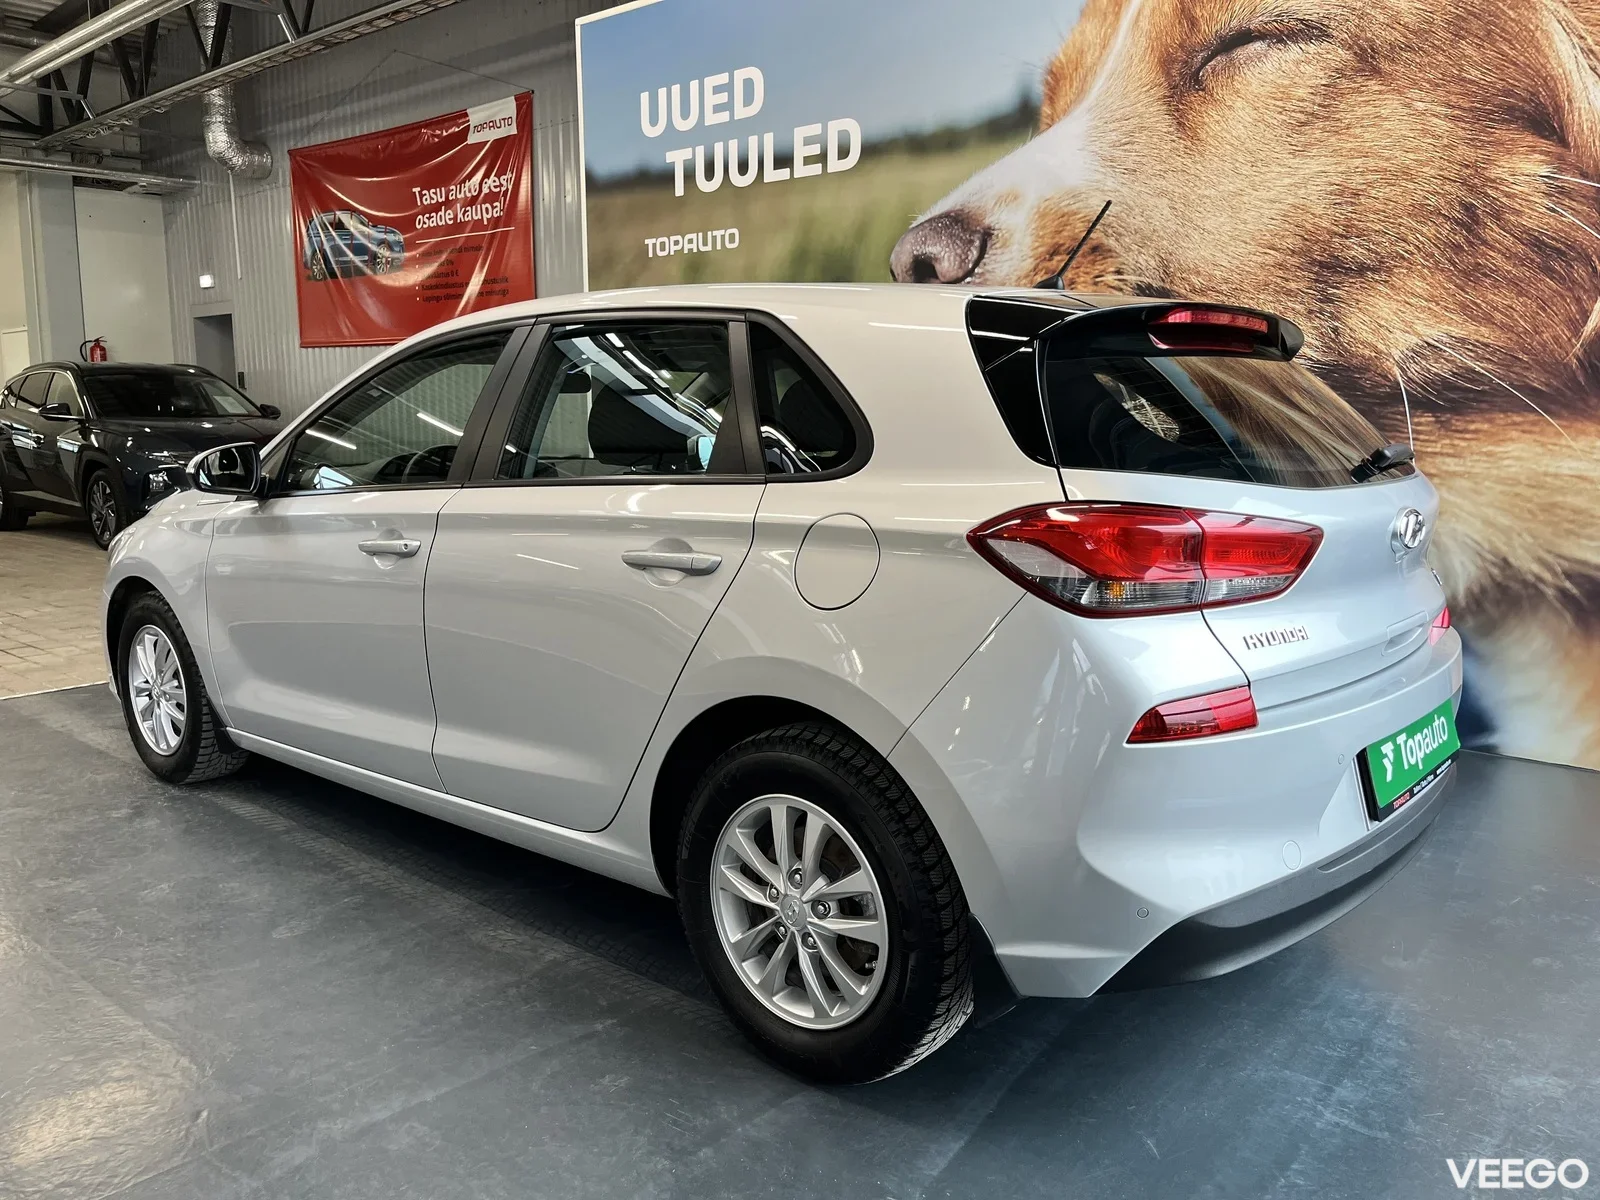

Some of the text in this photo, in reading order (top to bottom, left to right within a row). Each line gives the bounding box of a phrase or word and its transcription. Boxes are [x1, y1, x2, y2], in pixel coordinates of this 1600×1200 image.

[640, 66, 764, 137] UUED
[472, 116, 513, 134] TOPAUTO
[665, 118, 862, 197] TUULED
[412, 171, 513, 207] Tasu auto eest
[415, 196, 504, 229] osade kaupa!
[644, 228, 740, 258] TOPAUTO
[1396, 714, 1448, 770] Topauto
